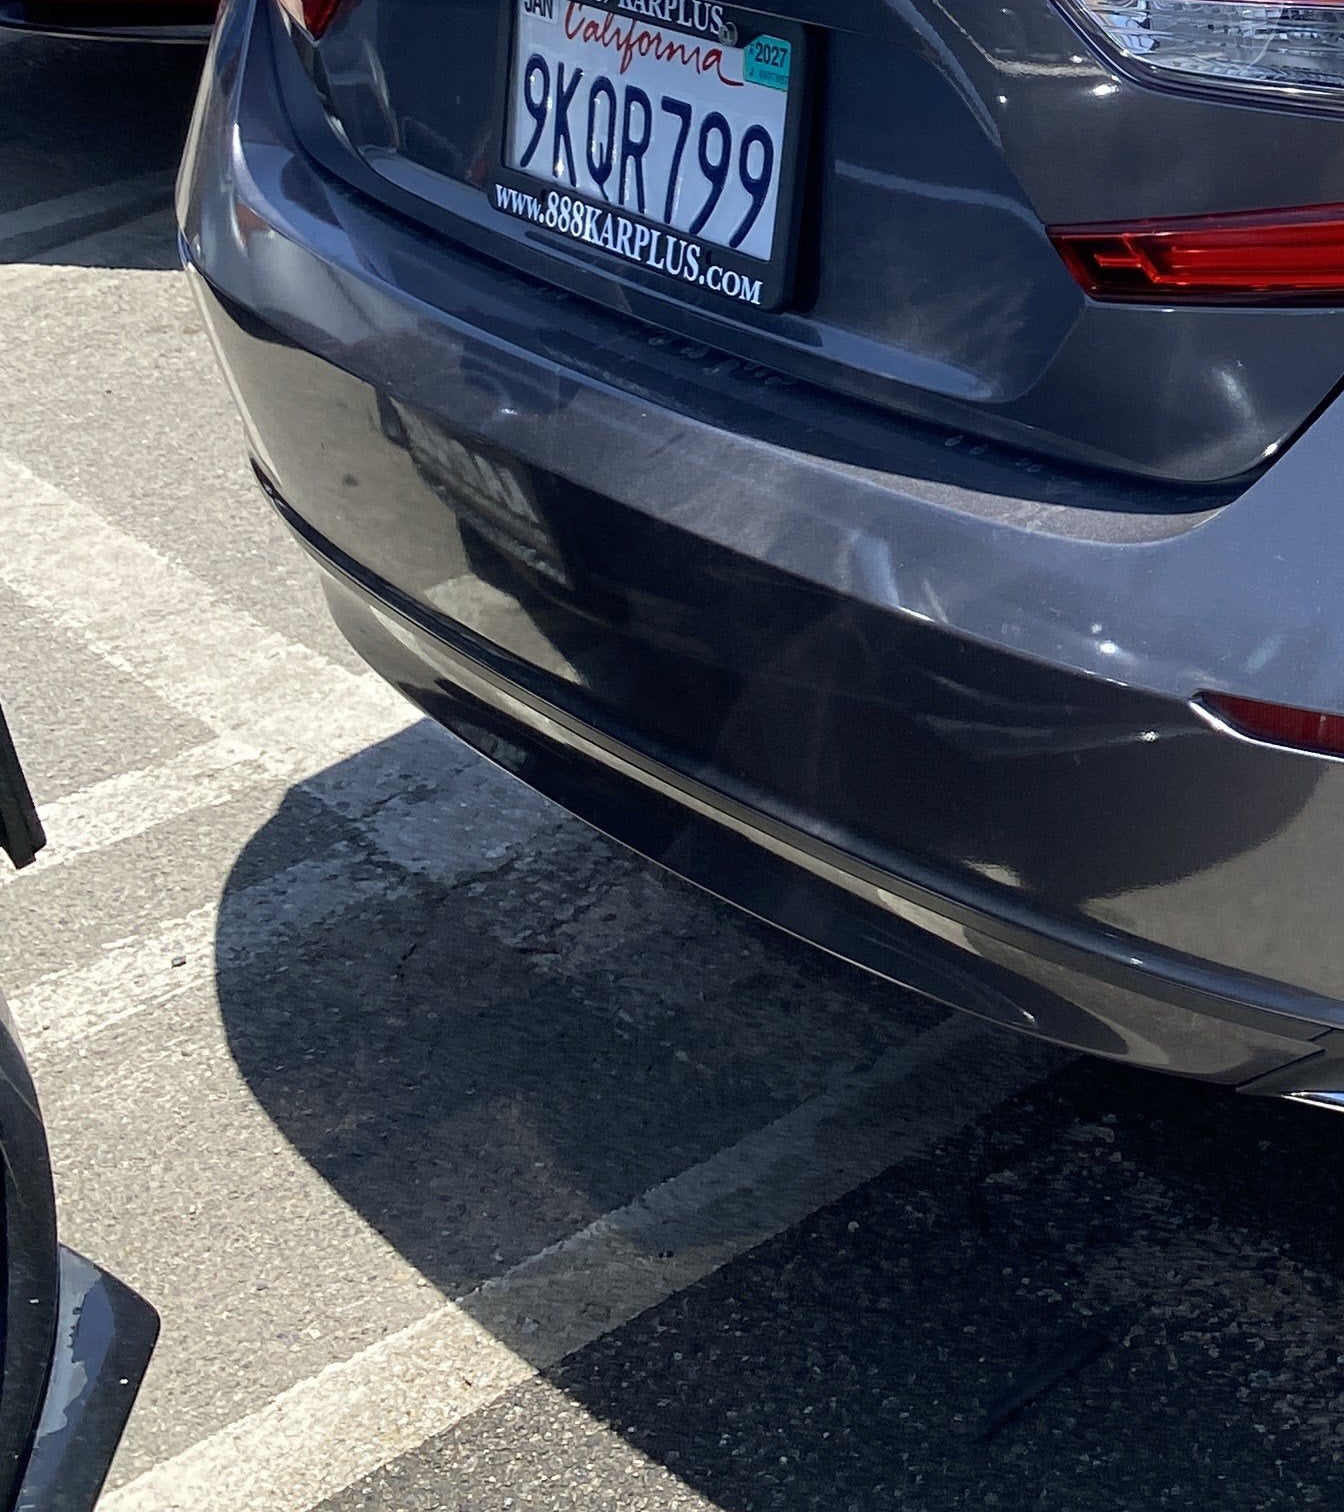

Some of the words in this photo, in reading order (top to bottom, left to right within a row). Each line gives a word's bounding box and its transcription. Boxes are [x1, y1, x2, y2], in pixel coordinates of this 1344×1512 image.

[564, 0, 744, 86] California
[755, 41, 789, 68] 2027
[519, 53, 775, 248] 9KQR799
